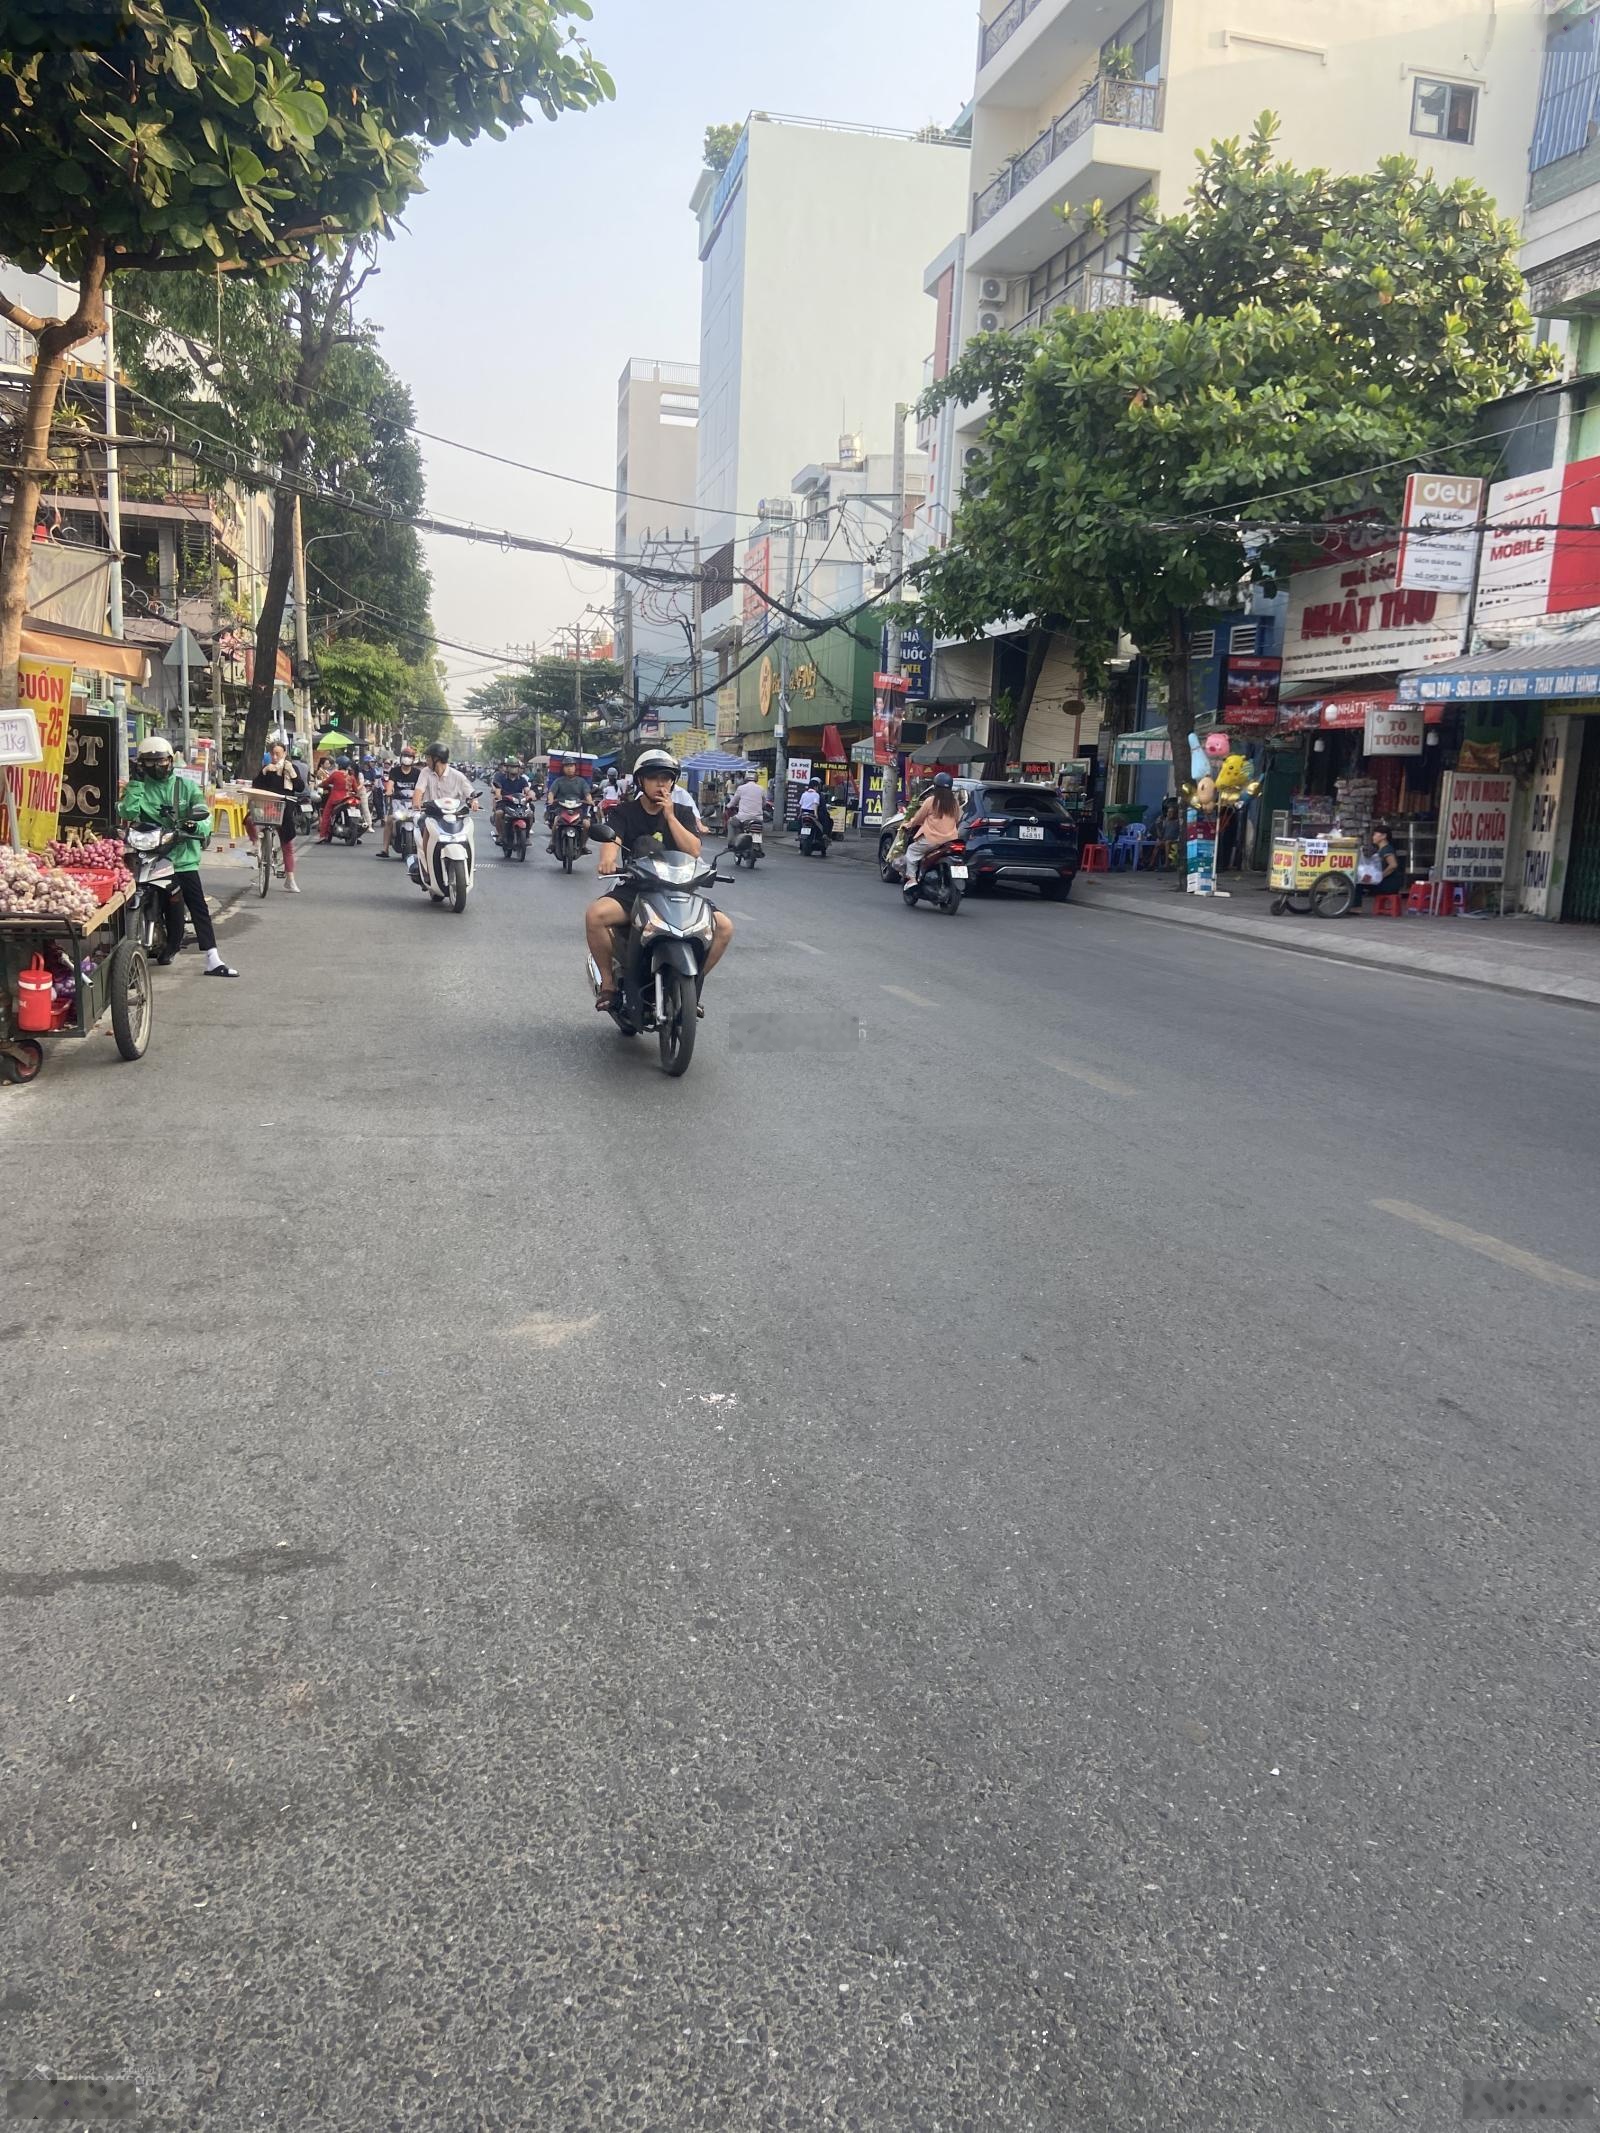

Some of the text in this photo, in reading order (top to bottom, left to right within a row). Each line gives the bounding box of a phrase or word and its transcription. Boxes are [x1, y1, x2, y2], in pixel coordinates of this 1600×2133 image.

[1423, 482, 1473, 504] deli
[1490, 537, 1545, 562] MOBILE
[1368, 557, 1396, 583] SÁC
[1301, 588, 1376, 645] NHẬT
[900, 645, 927, 660] UỐC
[47, 707, 63, 747] 25
[64, 726, 104, 766] ỚT
[791, 769, 808, 779] 15K
[60, 775, 101, 815] ỐC
[866, 794, 883, 813] TÂ
[1329, 855, 1354, 869] CUA
